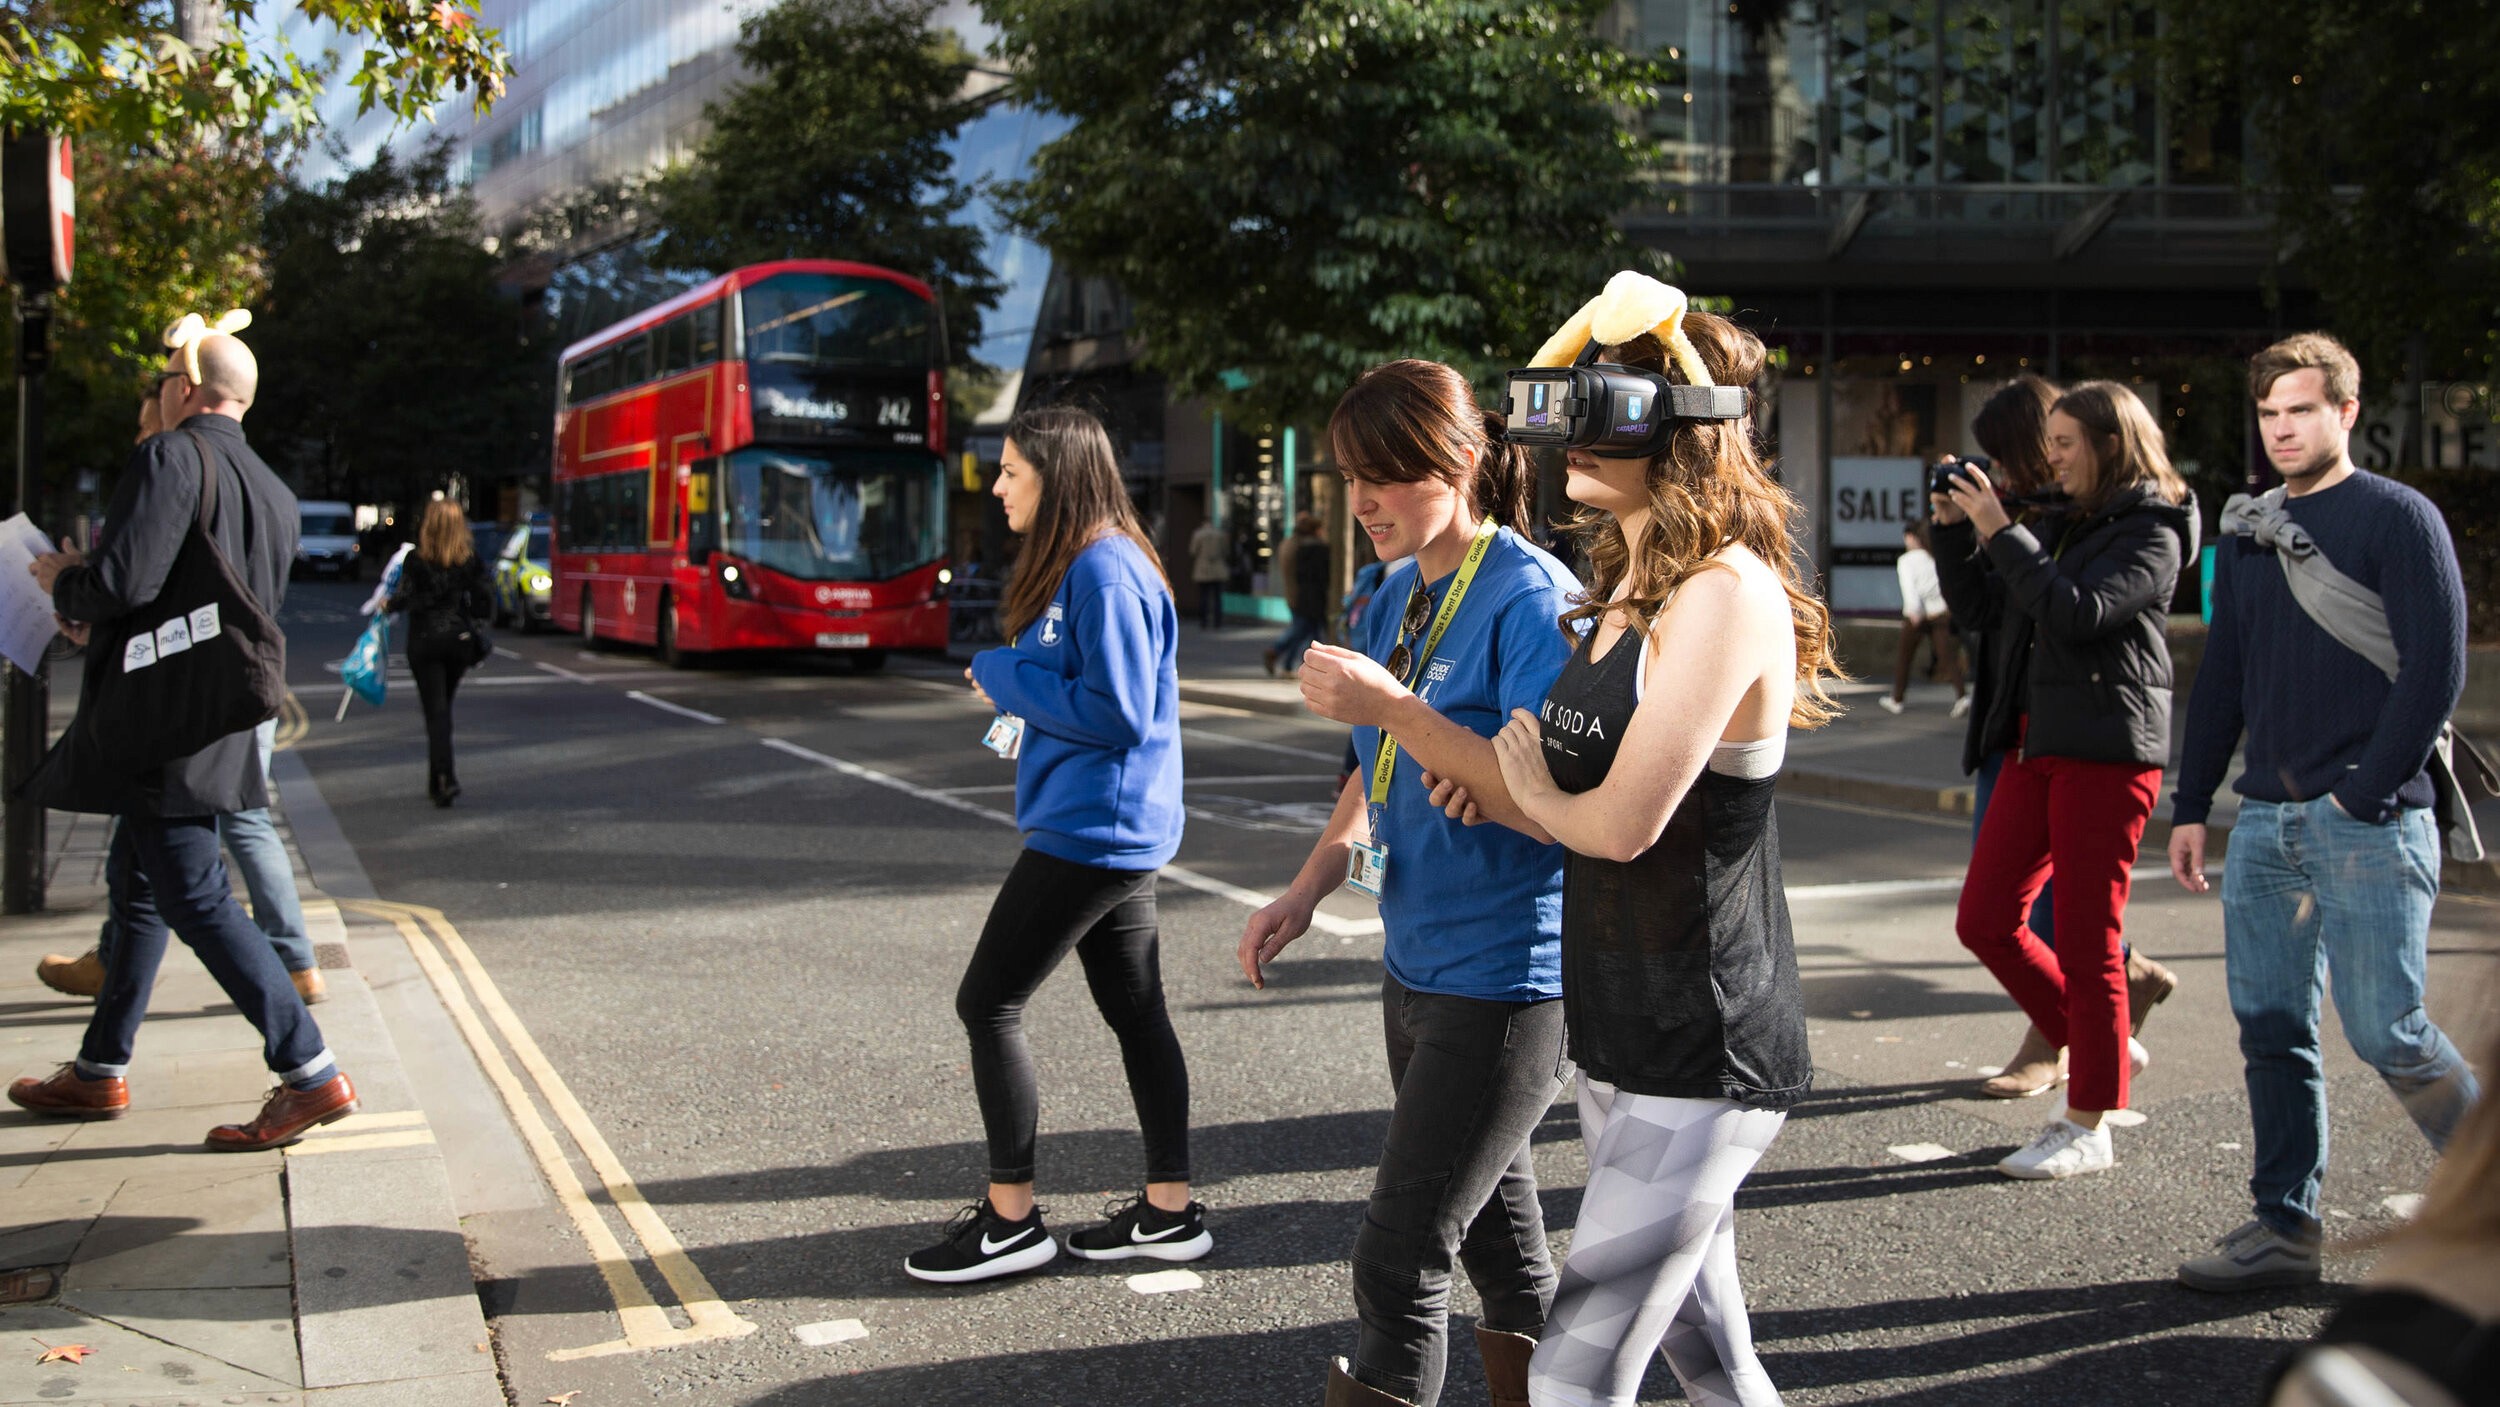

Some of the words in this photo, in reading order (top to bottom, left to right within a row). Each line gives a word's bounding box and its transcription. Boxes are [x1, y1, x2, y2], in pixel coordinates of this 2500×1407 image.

[877, 397, 911, 426] 242
[1616, 423, 1649, 433] CATAPULT
[1837, 486, 1916, 523] SALE
[1469, 538, 1486, 563] Guide
[1430, 621, 1445, 642] Dogs
[1440, 597, 1457, 621] Event
[1451, 579, 1466, 597] Staff
[1426, 670, 1447, 682] DOGS
[1430, 662, 1451, 673] GUIDE
[1555, 705, 1605, 740] SODA
[1384, 736, 1396, 757] Dog
[1546, 736, 1563, 752] SPORT
[1378, 758, 1391, 783] Guide
